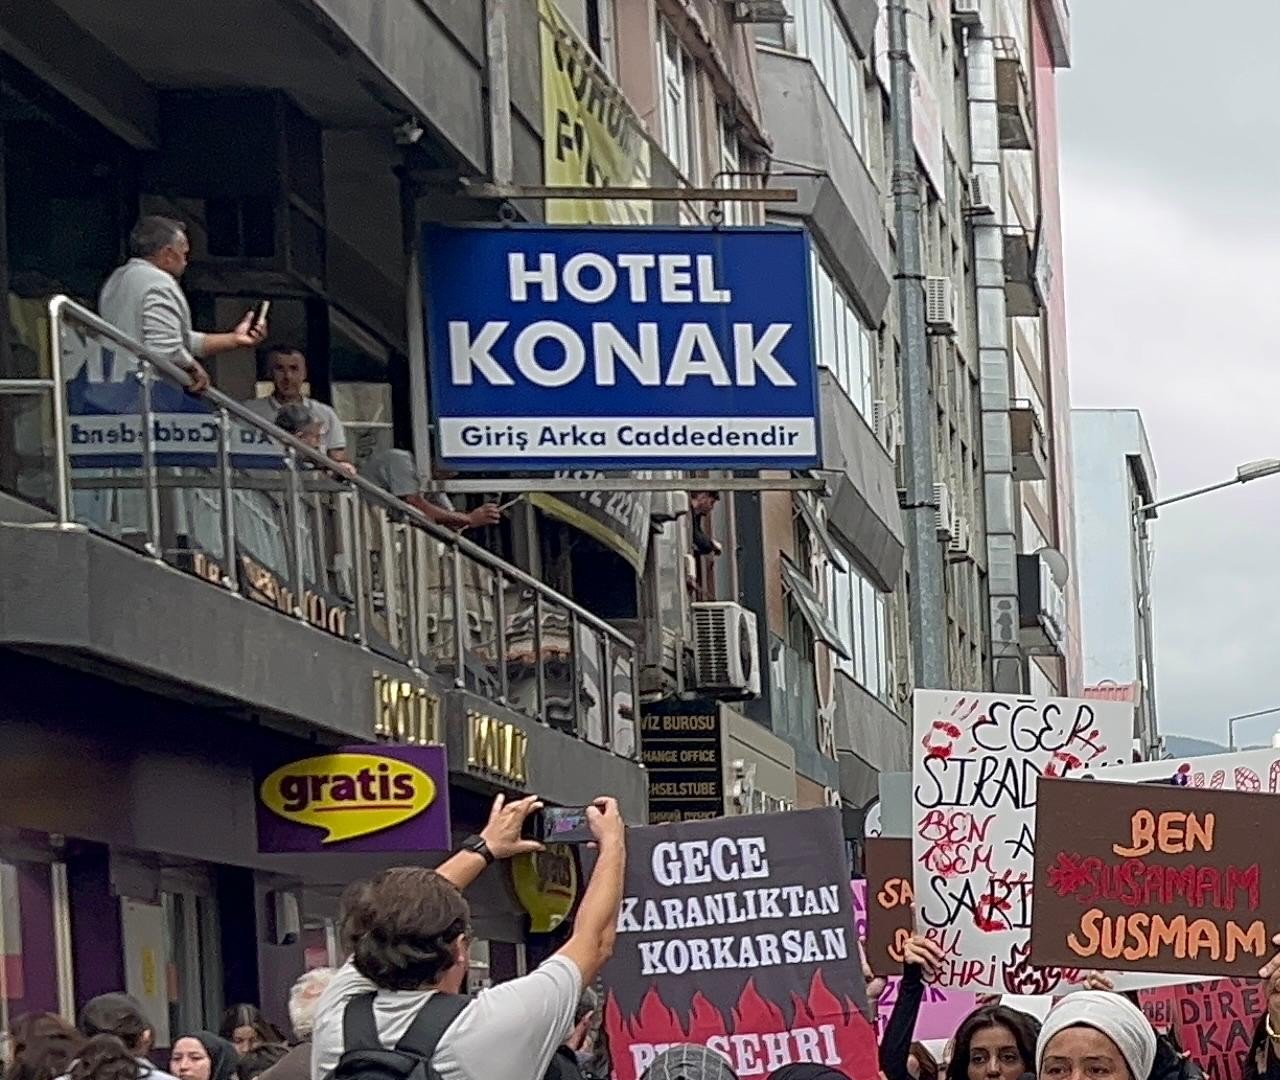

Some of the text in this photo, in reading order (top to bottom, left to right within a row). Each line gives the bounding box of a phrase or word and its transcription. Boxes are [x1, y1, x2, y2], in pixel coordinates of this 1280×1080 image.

[508, 252, 732, 304] HOTEL
[448, 320, 798, 388] KONAK
[460, 423, 800, 452] Giriş Arka Caddedendir
[663, 714, 716, 731] BUROSU
[971, 698, 1101, 753] EĞER
[641, 750, 716, 763] HANGE OFFICE
[279, 763, 416, 816] gratis
[650, 781, 717, 796] HSELSTUBE
[1112, 809, 1215, 858] BEN
[651, 835, 770, 887] GECE
[1046, 850, 1261, 911] #SUSAMAM
[615, 884, 841, 935] KARANLIKTAN
[637, 926, 849, 976] KORKARSAN
[1066, 907, 1266, 964] SUSMAM
[1180, 985, 1262, 1025] DİRE
